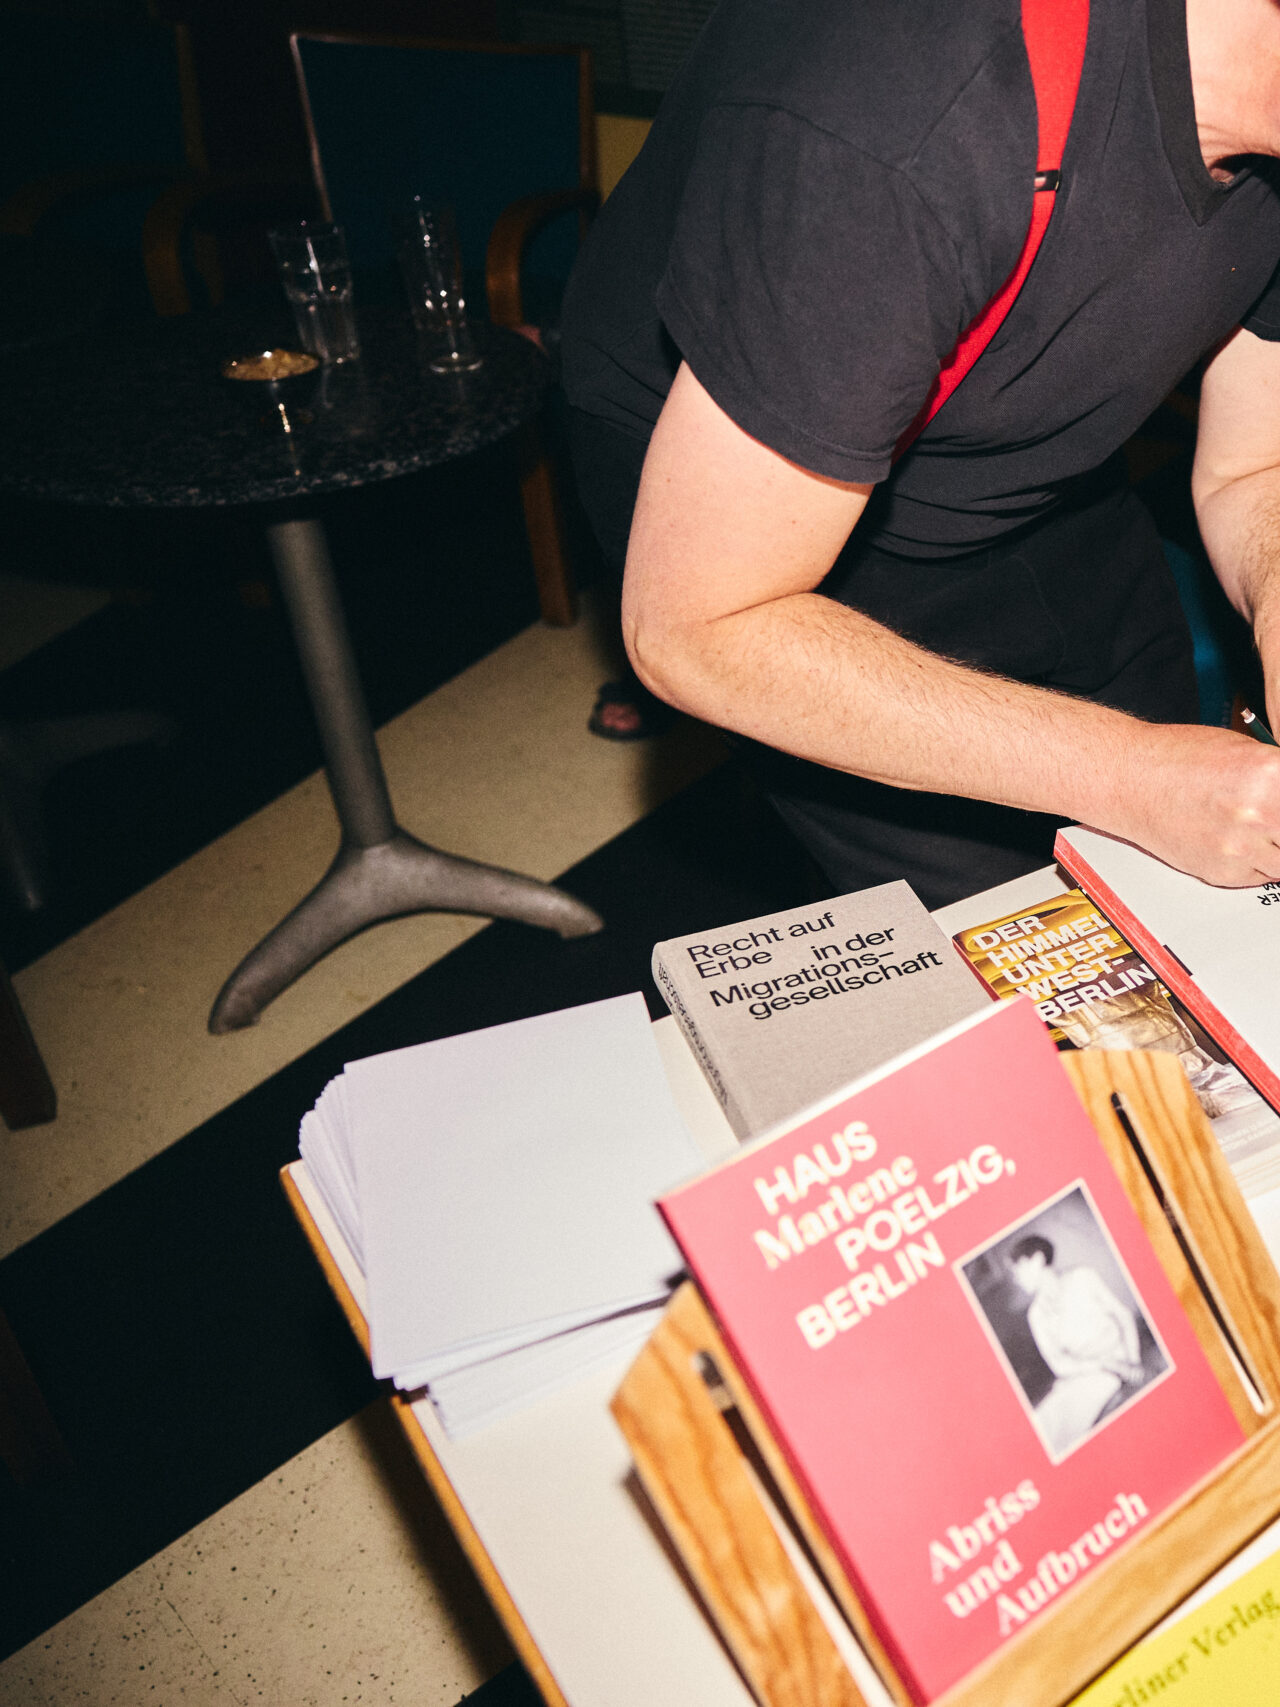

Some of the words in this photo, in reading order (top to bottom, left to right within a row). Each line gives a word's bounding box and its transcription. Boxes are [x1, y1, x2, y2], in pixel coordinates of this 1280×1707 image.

[686, 918, 783, 963] Recht
[788, 911, 836, 942] auf
[695, 947, 773, 979] Erbe
[810, 942, 840, 962] in
[842, 924, 896, 958] der
[972, 915, 1047, 951] DER
[986, 911, 1111, 968] HIMMEL
[1001, 932, 1118, 984] UNTER
[748, 949, 944, 1022] gesellschaft
[1016, 954, 1126, 1001] WEST-
[1033, 963, 1158, 1023] BERLIN
[754, 1122, 877, 1215] HAUS
[753, 1155, 918, 1270] Marlene
[834, 1144, 1017, 1271] POELZIG,
[796, 1233, 946, 1350] BERLIN
[929, 1479, 1041, 1585] Abriss
[996, 1492, 1149, 1636] Aufbruch
[944, 1539, 1023, 1618] und
